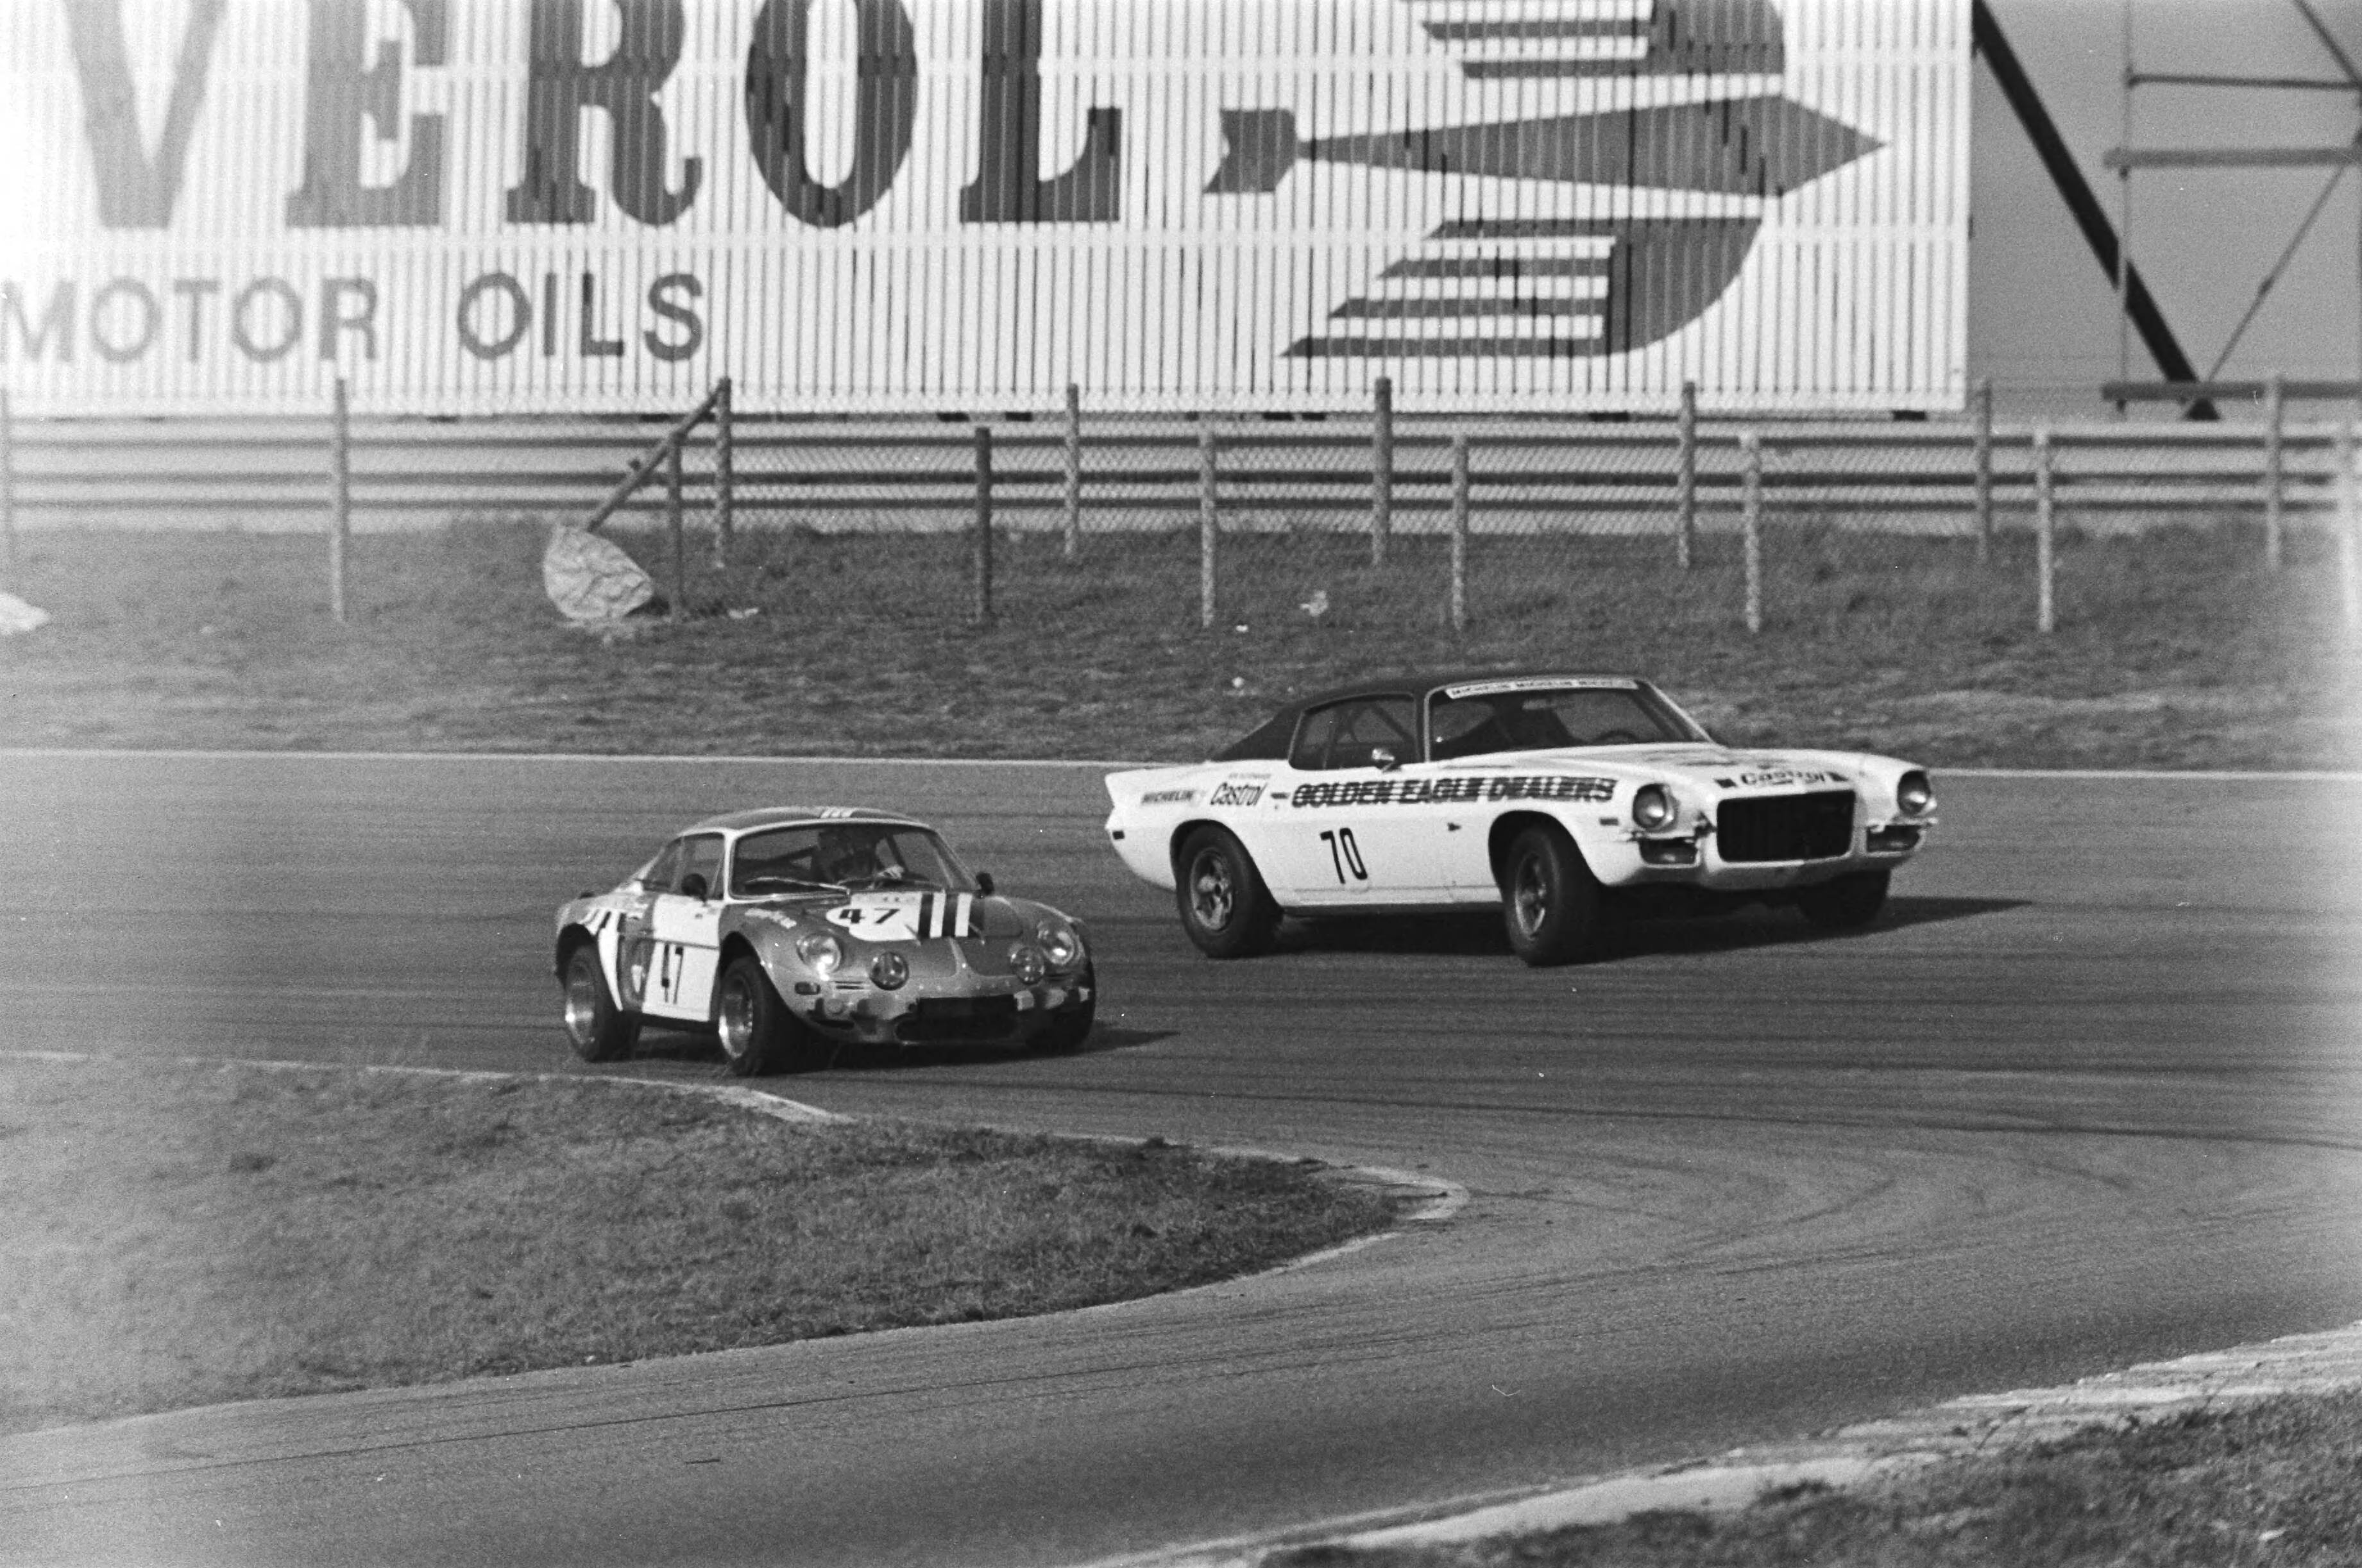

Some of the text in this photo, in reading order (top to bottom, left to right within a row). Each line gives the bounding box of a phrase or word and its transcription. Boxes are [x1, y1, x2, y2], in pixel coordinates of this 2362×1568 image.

[0, 272, 703, 364] MOTOR OILS
[1210, 782, 1268, 806] Castrol
[1291, 781, 1396, 808] GOLDEN
[1398, 778, 1486, 805] EAGLE
[1320, 827, 1368, 884] 70
[839, 909, 901, 925] 47
